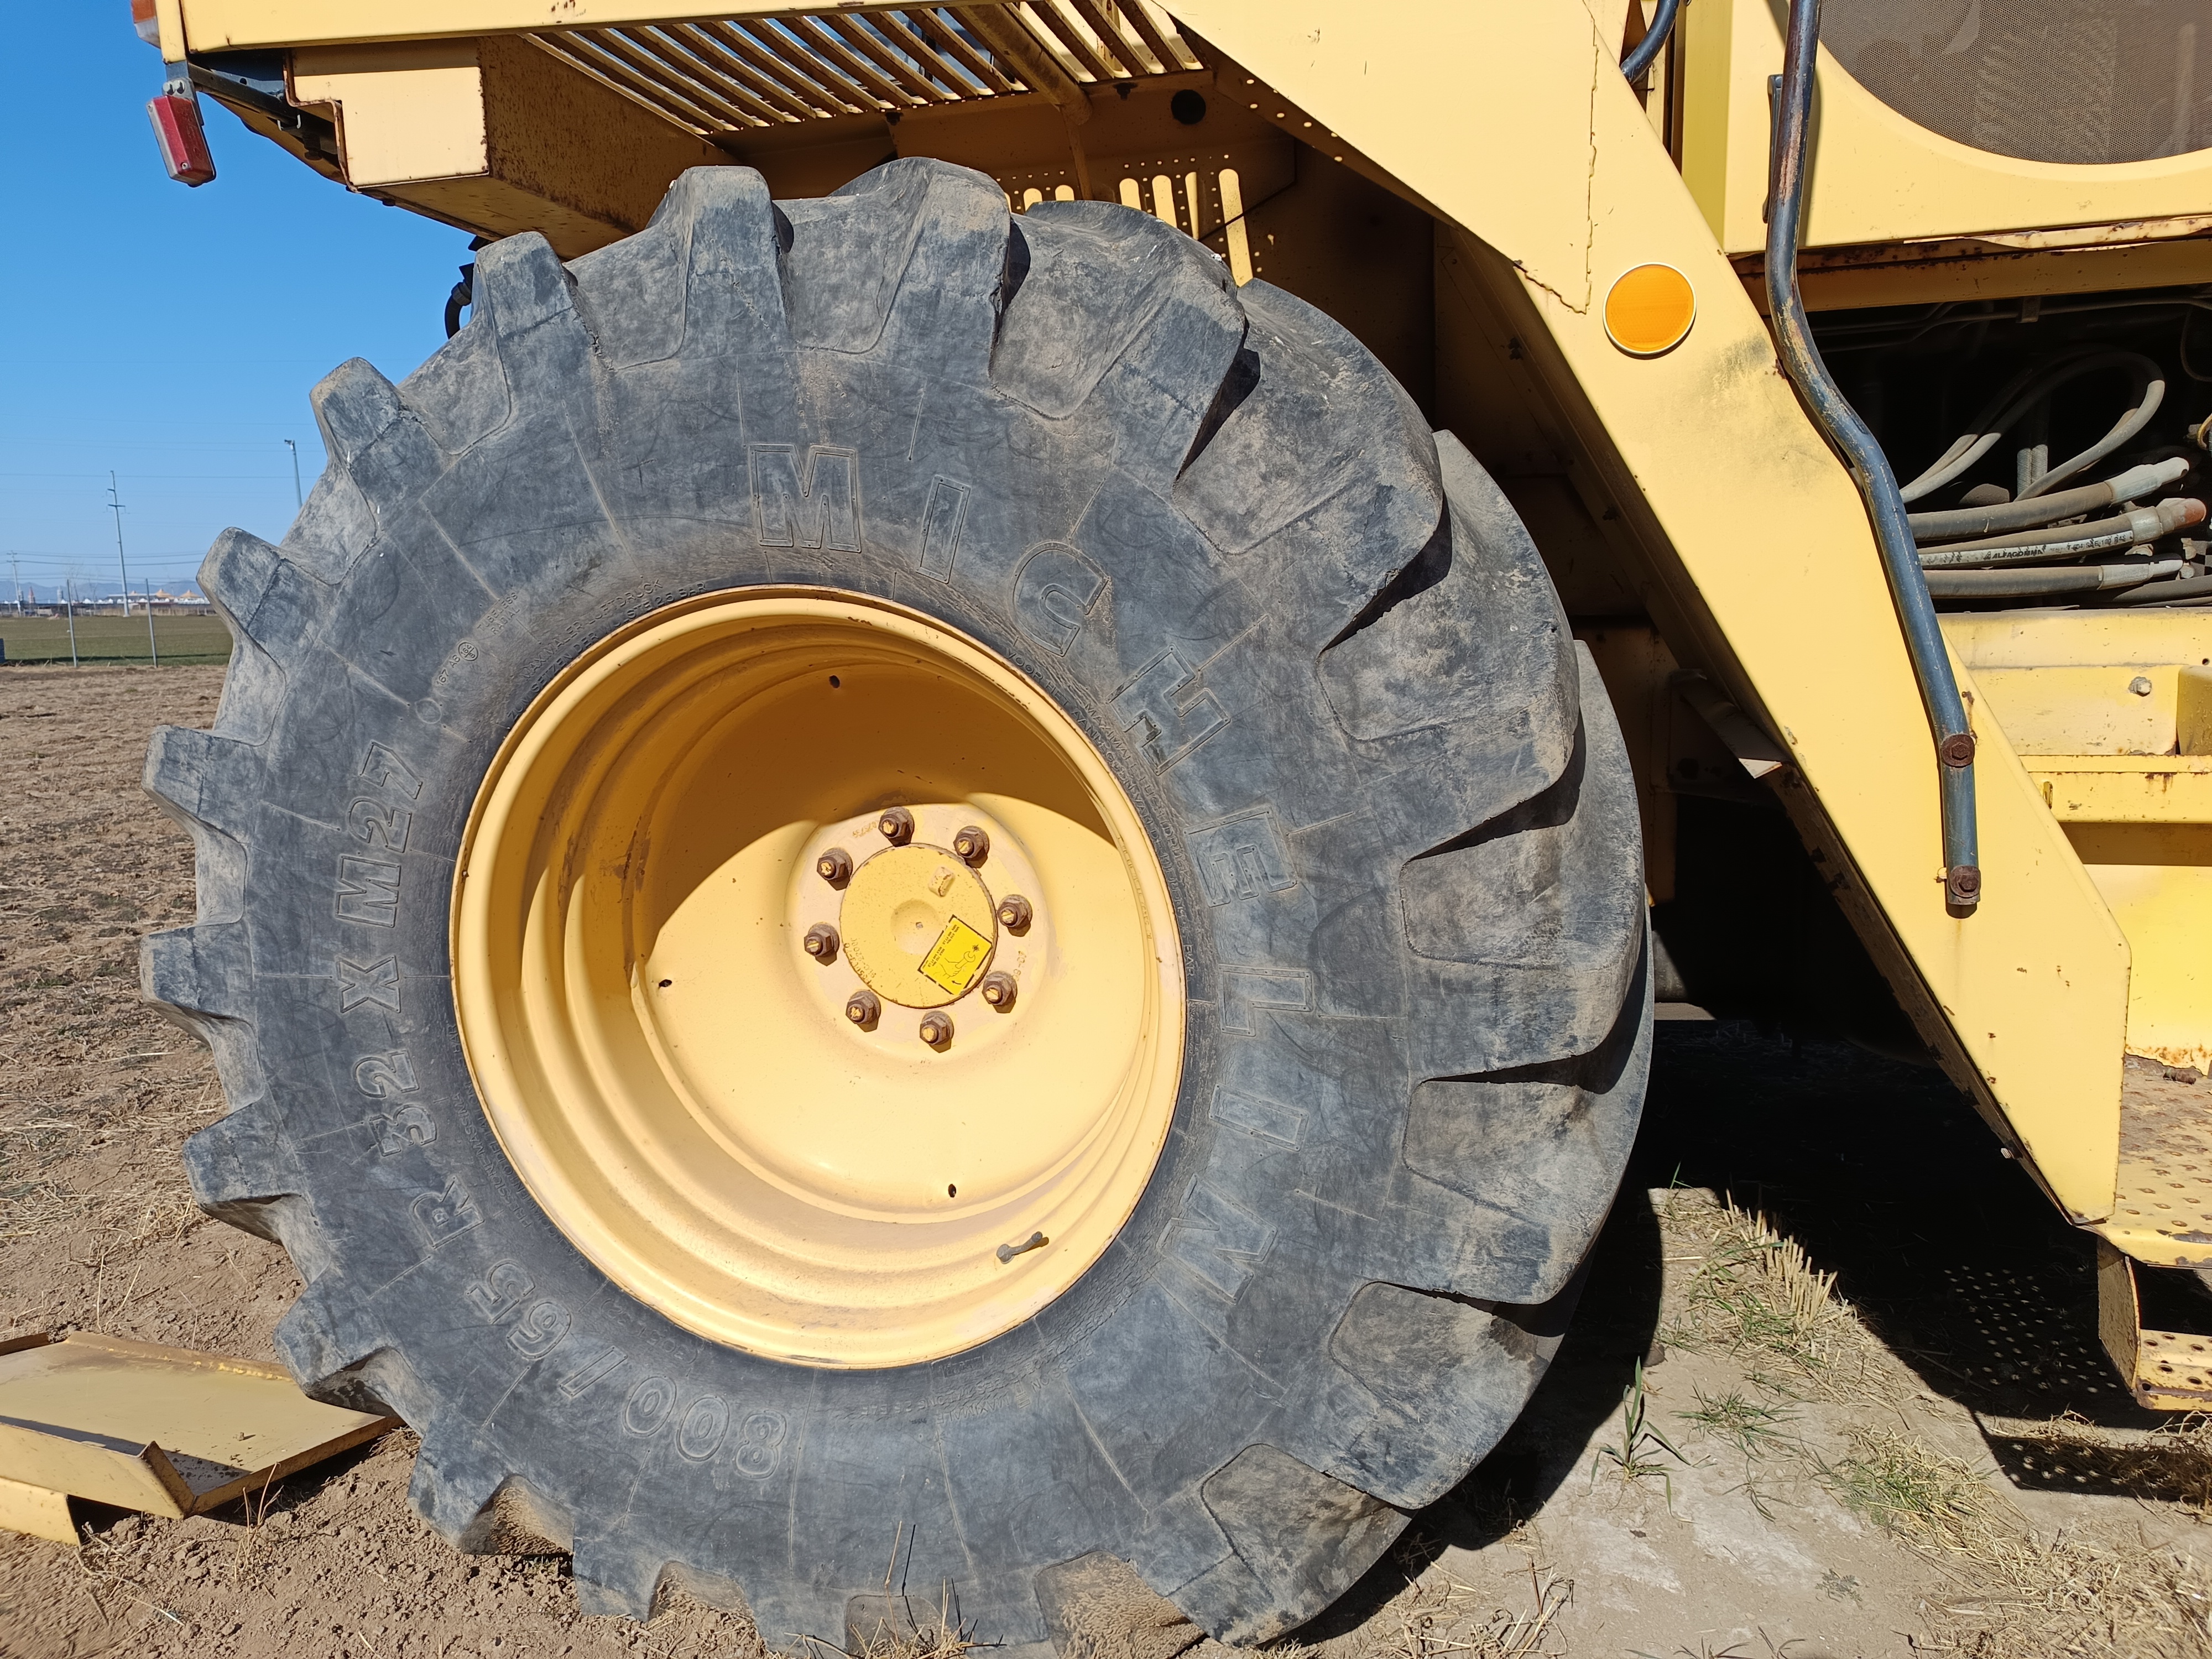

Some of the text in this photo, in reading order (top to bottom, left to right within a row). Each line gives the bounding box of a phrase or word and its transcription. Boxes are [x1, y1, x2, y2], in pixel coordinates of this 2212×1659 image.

[1991, 549, 2043, 560] ALFAGOMMA
[476, 589, 520, 636] TUBELESS RADIAL
[519, 577, 662, 682] MAXIMALER LUFTDRUCK
[435, 668, 451, 687] 167
[460, 642, 473, 657] 164
[505, 690, 533, 723] ZUM
[529, 649, 573, 695] SETZEN
[572, 629, 599, 655] DER
[599, 599, 653, 636] WULSTE
[677, 580, 707, 598] BAR
[1083, 701, 1141, 775] MAXIMALE
[1003, 646, 1045, 684] VOOR
[1044, 680, 1071, 708] HET
[1130, 791, 1155, 827] VAN
[1182, 943, 1197, 977] BAR
[748, 442, 1313, 1305] MICHELIN
[446, 1024, 462, 1053] BAR
[336, 741, 787, 1479] 800/65 R 32 X M27
[449, 1091, 533, 1229] PRESSIONE MASSIMA
[1029, 1344, 1094, 1391] PRESSION
[934, 1392, 1010, 1426] MAXIMALE
